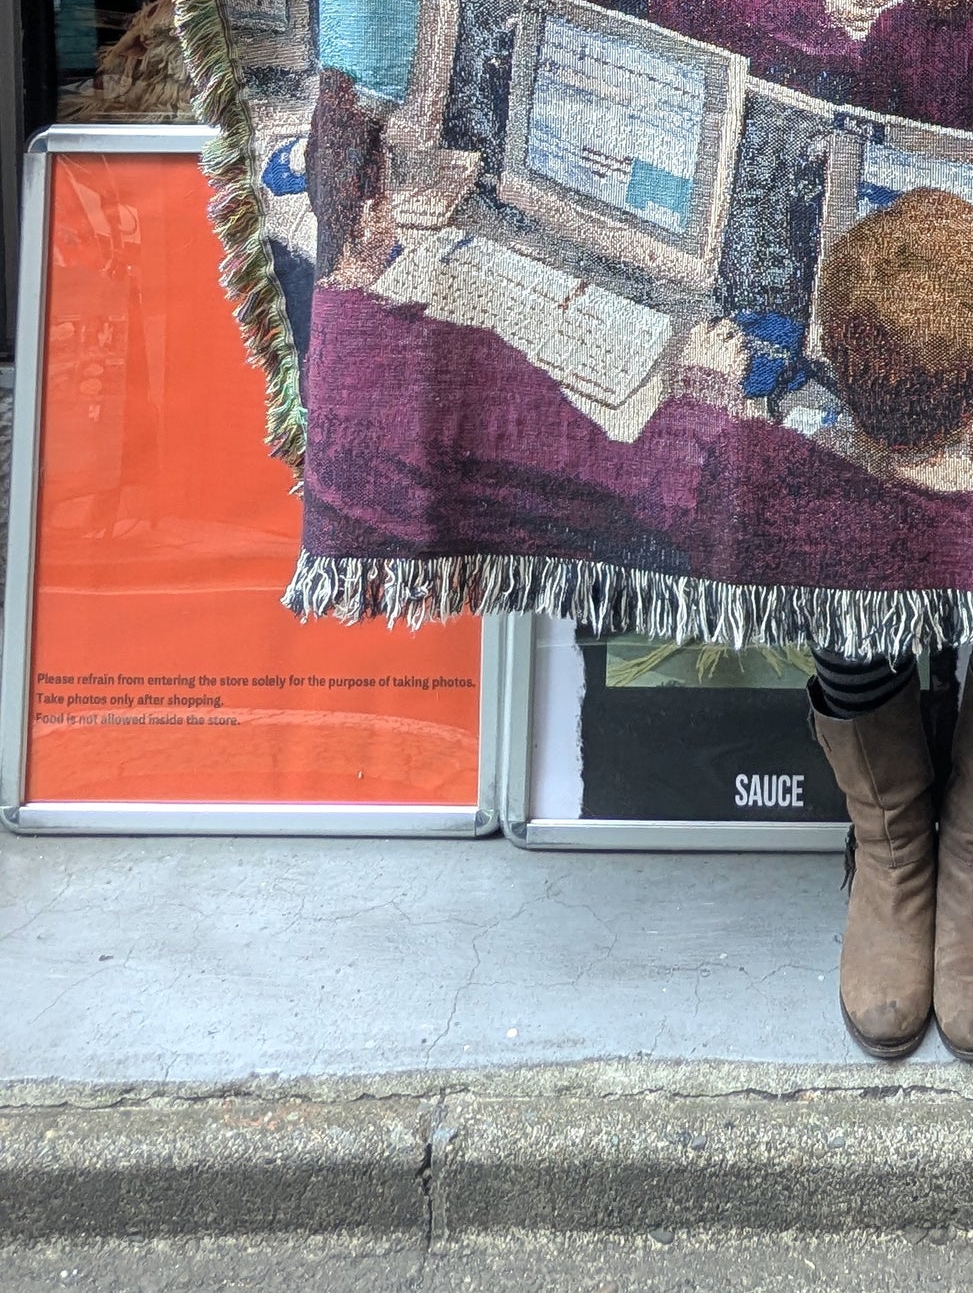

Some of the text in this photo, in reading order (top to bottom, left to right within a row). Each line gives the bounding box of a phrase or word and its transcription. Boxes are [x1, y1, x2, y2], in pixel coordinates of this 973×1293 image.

[38, 673, 476, 690] Please refrain from entering the store solely for the purpose of taking photos.
[36, 693, 224, 709] Take photos only after shopping.
[36, 712, 241, 726] Food is not allowed inside the store.
[734, 773, 805, 807] SAUCE
